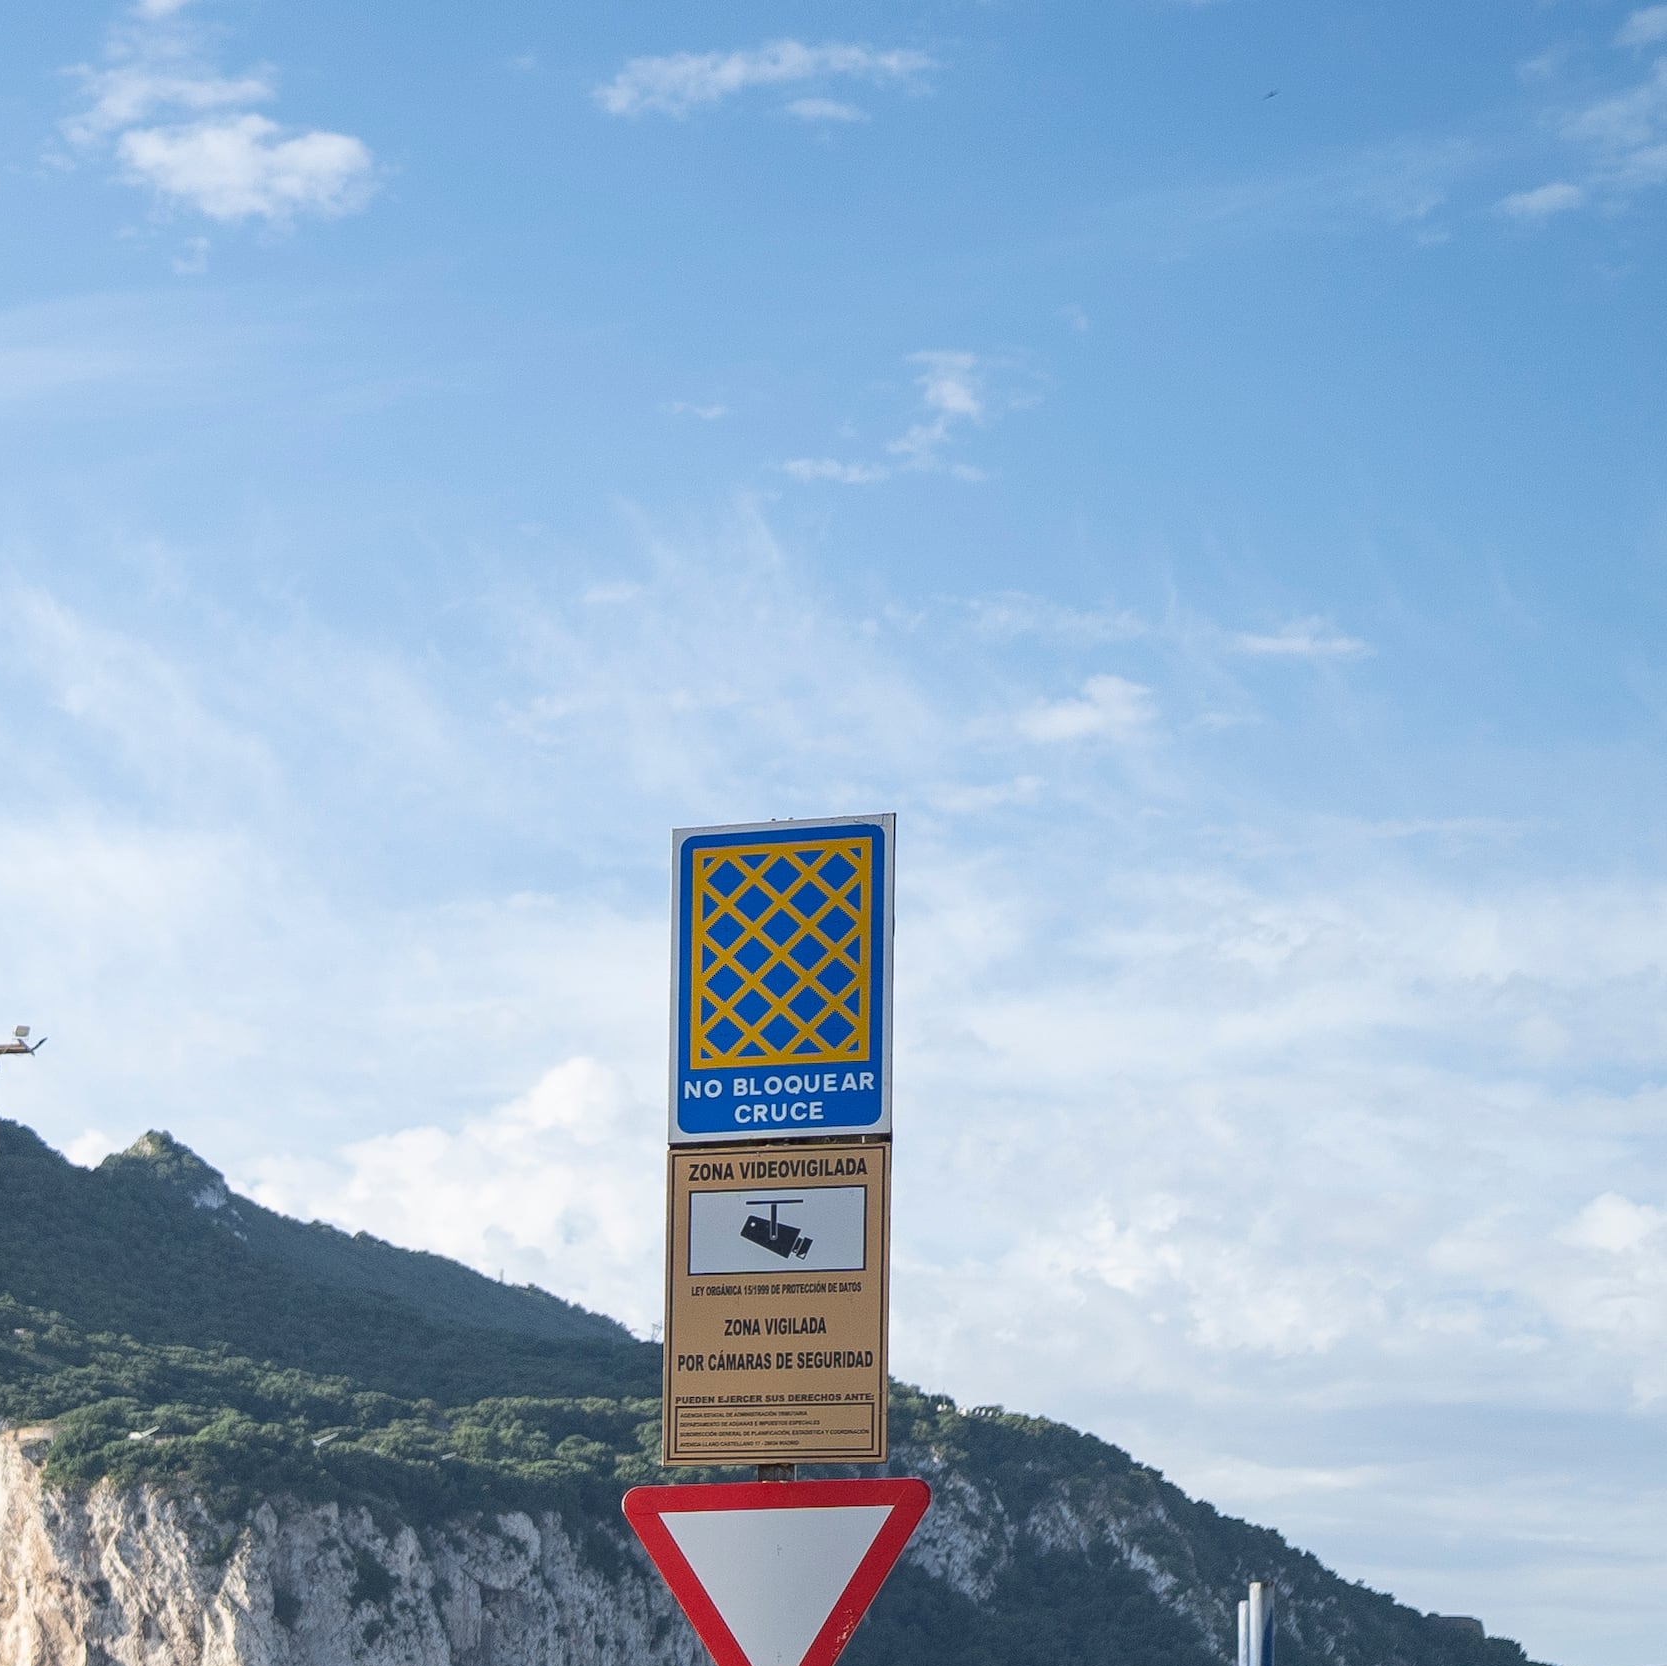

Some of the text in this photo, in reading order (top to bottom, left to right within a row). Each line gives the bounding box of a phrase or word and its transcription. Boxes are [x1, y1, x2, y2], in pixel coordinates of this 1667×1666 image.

[684, 1072, 875, 1099] NO BLOQUEAR
[734, 1101, 824, 1123] CRUCE
[688, 1158, 868, 1181] ZONA VIDEOVIGILADA
[691, 1286, 705, 1296] LEY
[771, 1284, 781, 1295] DE
[828, 1282, 838, 1293] DE
[839, 1281, 862, 1293] DATOS
[724, 1317, 827, 1336] ZONA VIGILADA
[677, 1350, 873, 1371] POR CÁMARAS DE SEGURIDAD
[675, 1396, 715, 1404] PUEDEN
[718, 1395, 762, 1403] EJERCER
[765, 1394, 785, 1402] SUS
[788, 1393, 842, 1402] DERECHOS
